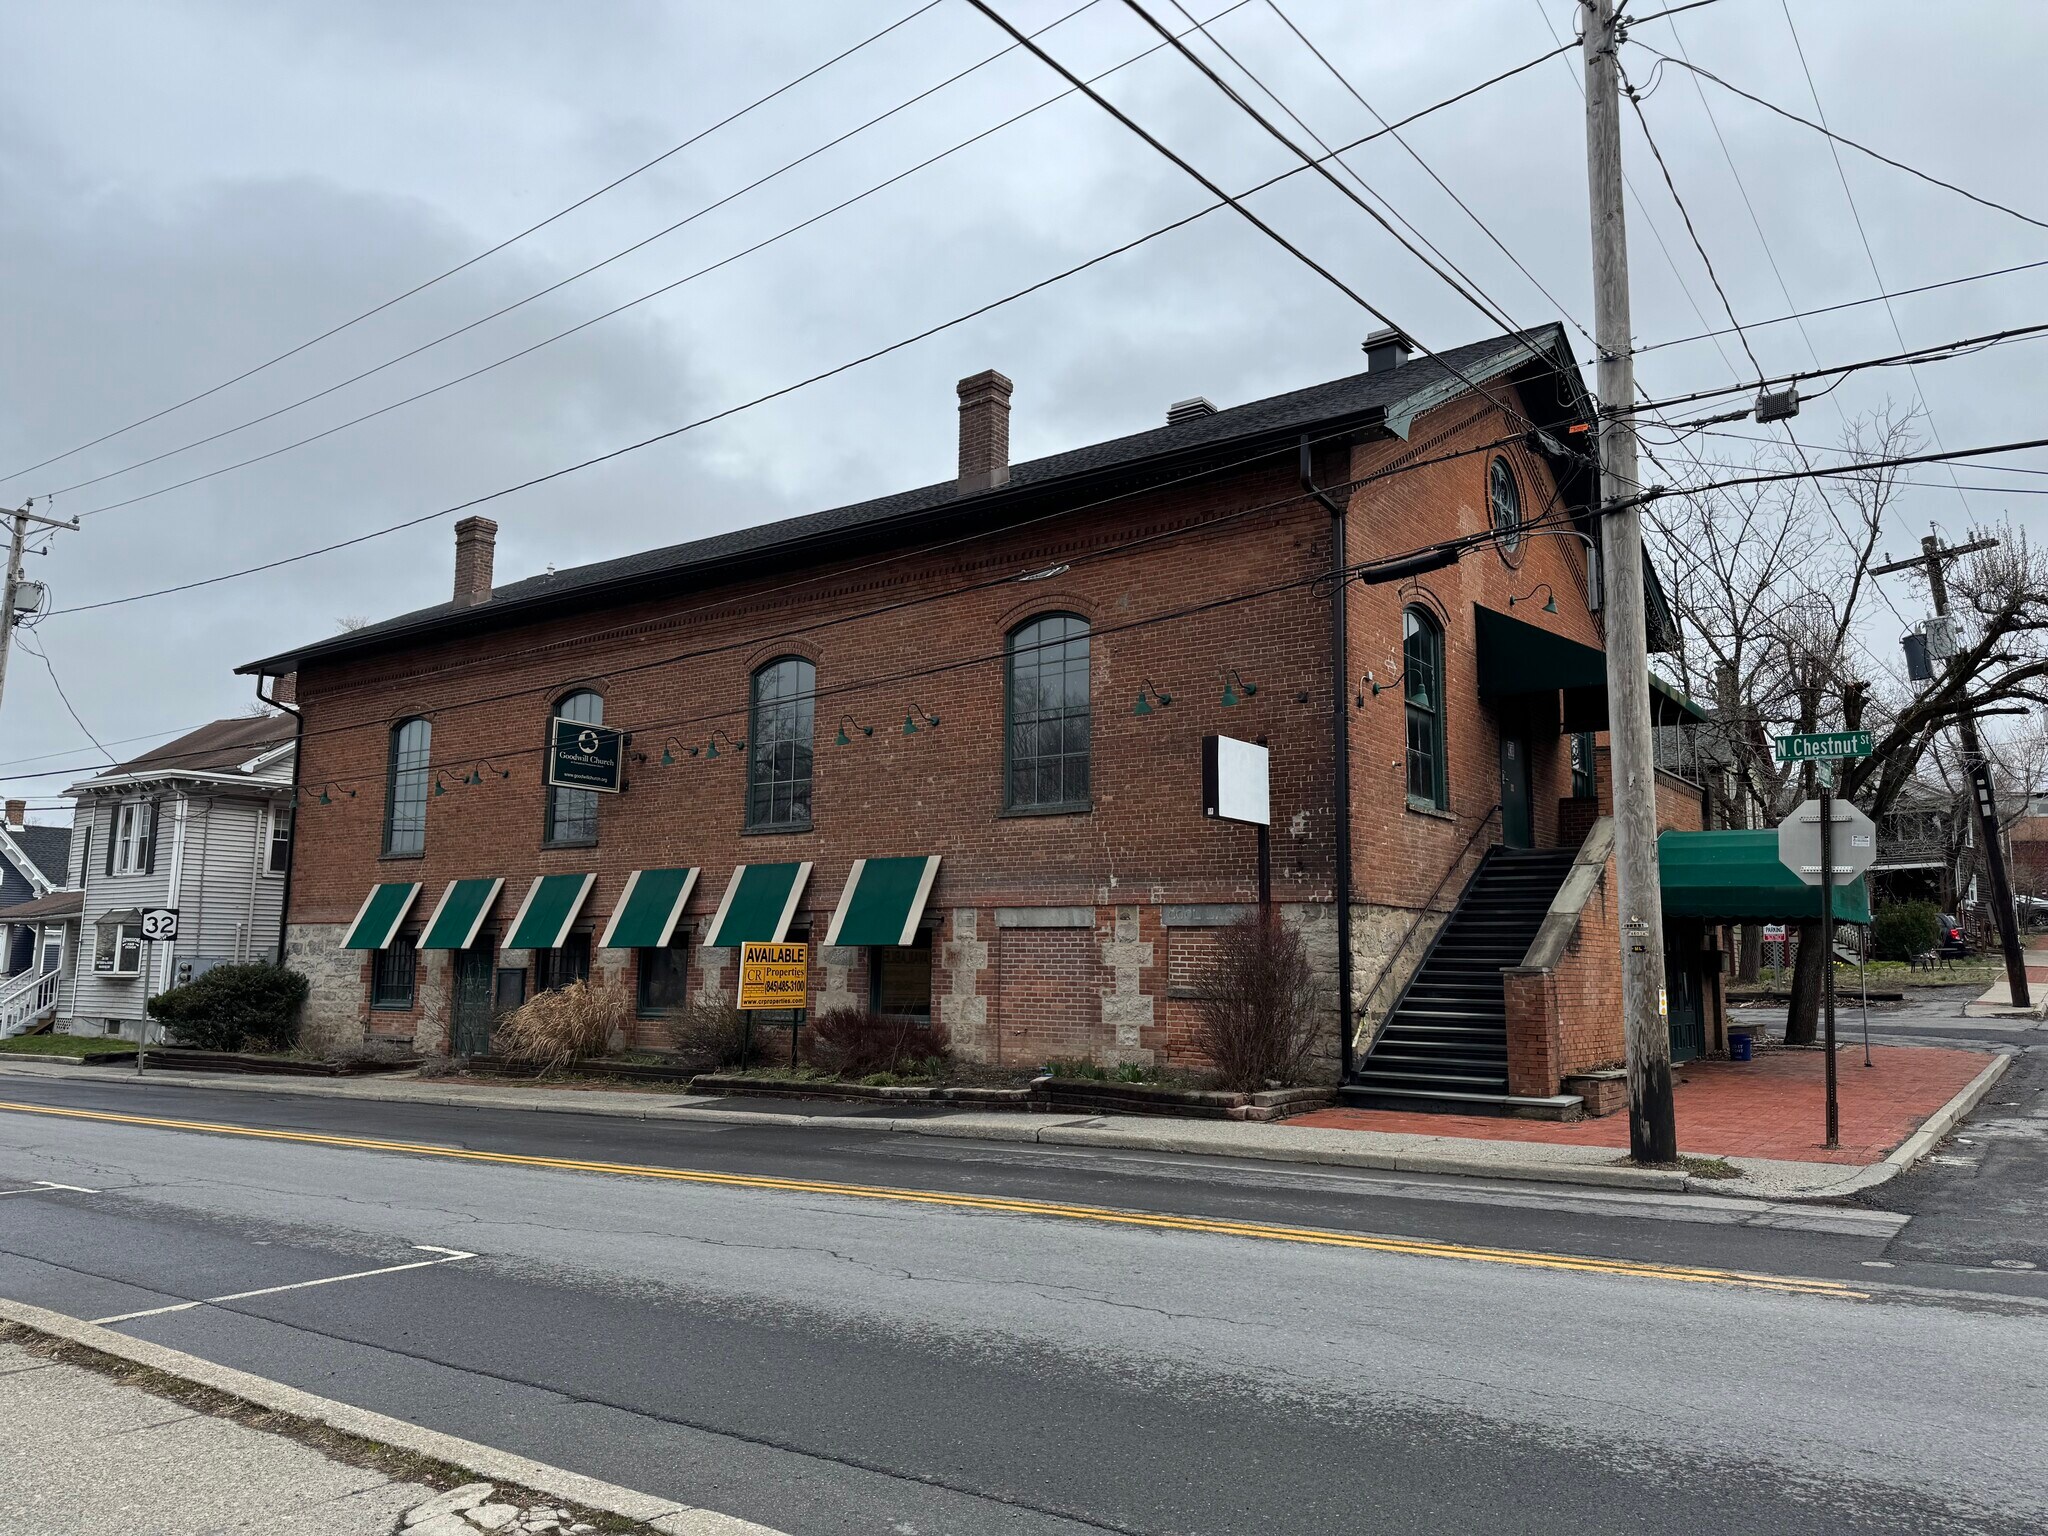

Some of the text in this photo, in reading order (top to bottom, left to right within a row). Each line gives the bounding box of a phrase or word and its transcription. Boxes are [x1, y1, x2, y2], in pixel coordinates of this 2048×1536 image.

[1777, 734, 1870, 757] N. Chestnut St
[559, 751, 589, 762] Goodwill
[590, 756, 614, 766] Church
[145, 916, 174, 934] 32
[746, 948, 804, 963] AVAILABLE
[747, 969, 762, 981] CR
[766, 968, 804, 978] Properties
[743, 998, 804, 1006] www.crproperties.com
